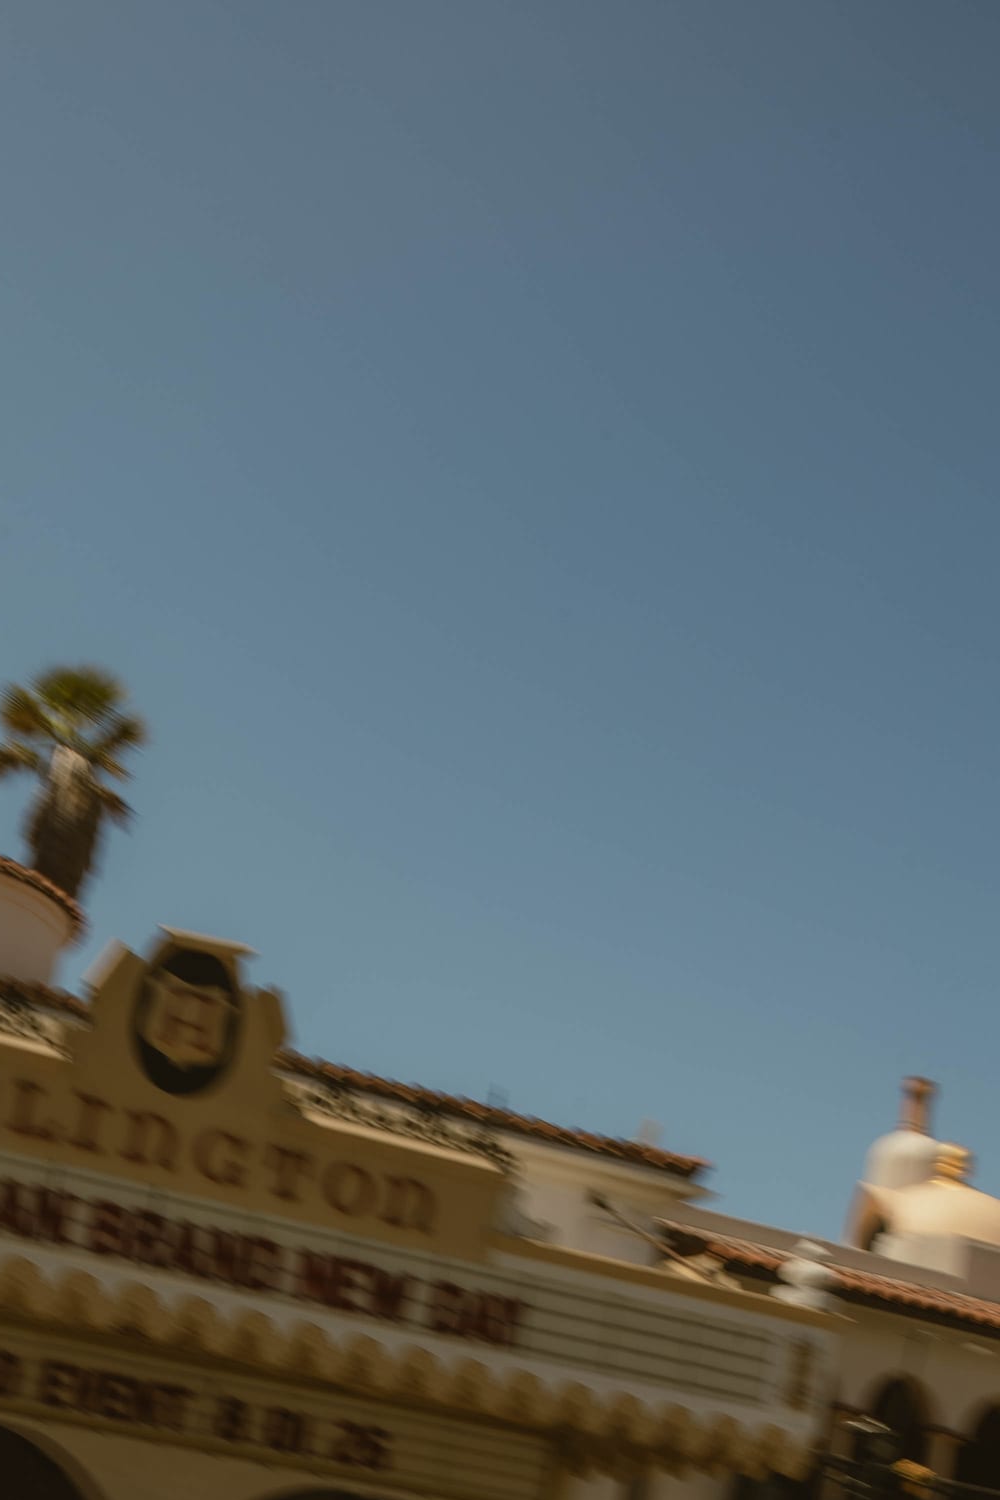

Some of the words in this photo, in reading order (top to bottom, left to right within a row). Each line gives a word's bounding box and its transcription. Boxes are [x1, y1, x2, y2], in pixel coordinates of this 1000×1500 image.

[87, 1197, 281, 1291] BRAND
[294, 1245, 407, 1320] NEW
[426, 1278, 522, 1347] DAY
[39, 1358, 192, 1430] EVENT
